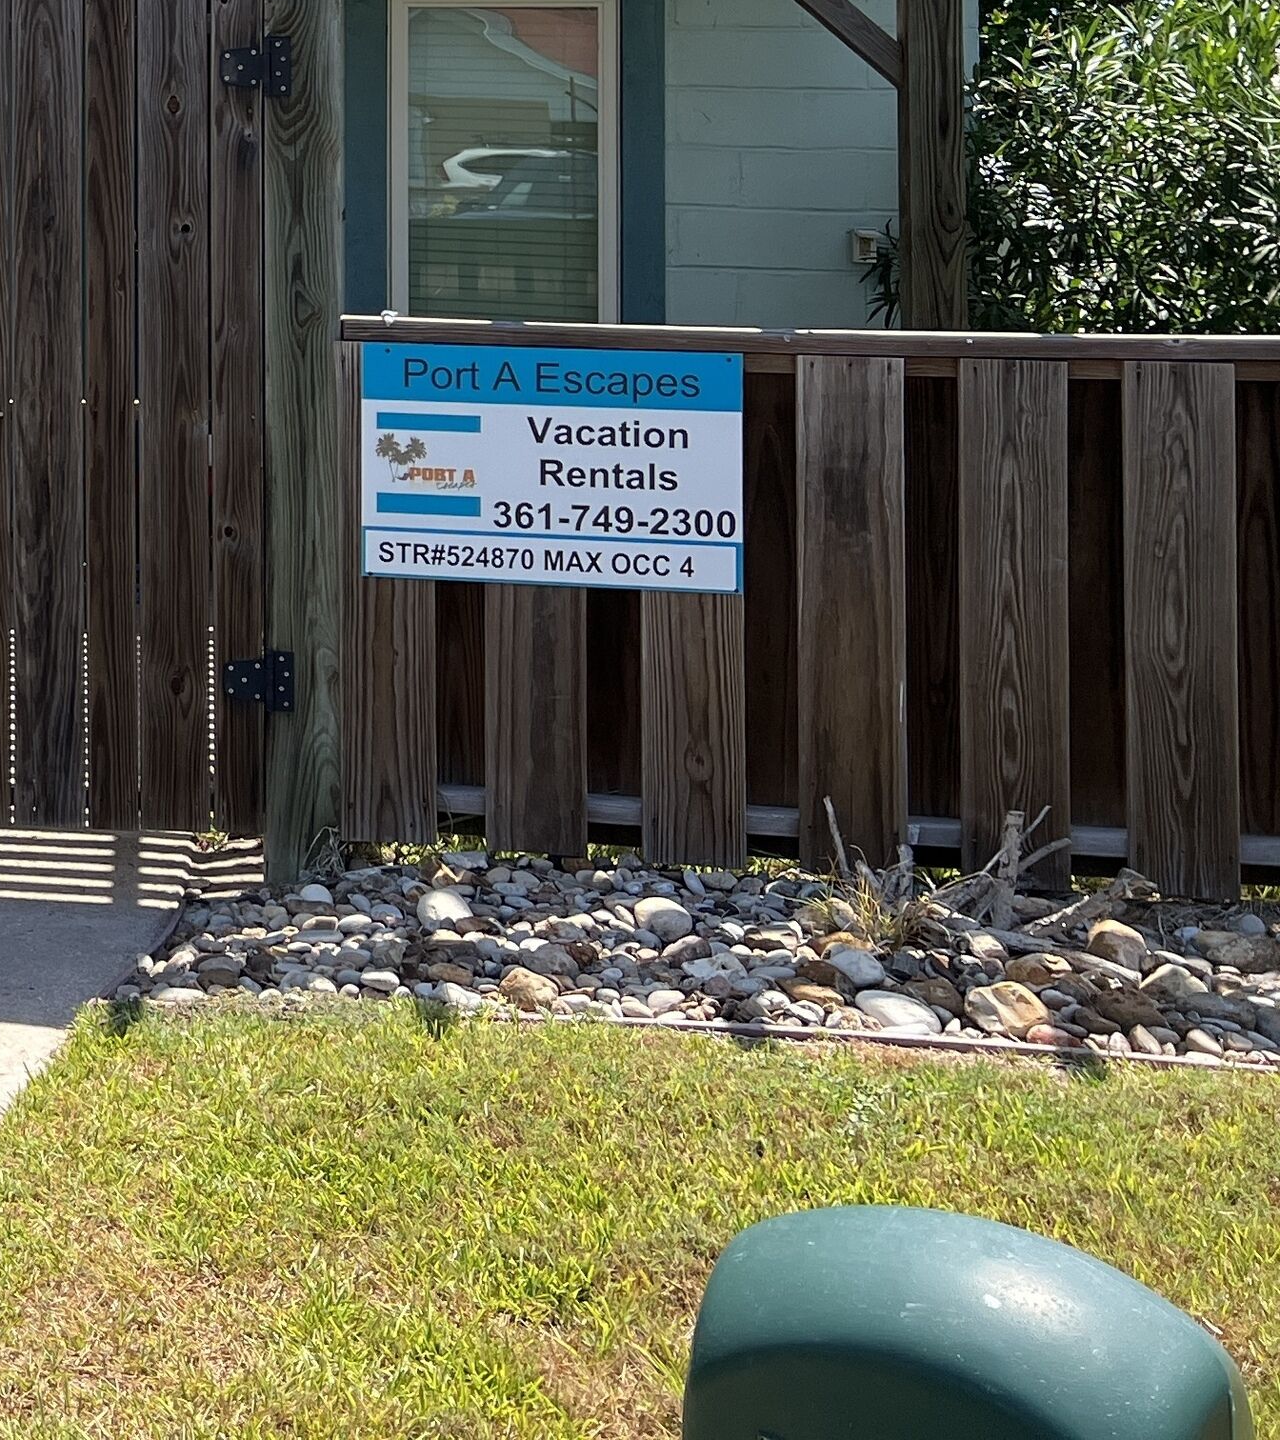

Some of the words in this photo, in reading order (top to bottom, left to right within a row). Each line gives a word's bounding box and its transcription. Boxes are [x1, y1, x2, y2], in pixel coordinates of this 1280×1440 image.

[403, 357, 480, 392] Port
[492, 361, 521, 392] A
[535, 362, 701, 403] Escapes
[526, 416, 689, 449] Vacation
[462, 469, 475, 483] A
[539, 459, 679, 491] Rentals
[492, 501, 737, 538] 361-749-2300
[378, 541, 535, 570] STR#524870
[543, 549, 603, 574] MAX
[610, 553, 670, 576] OCC
[679, 556, 695, 578] 4
